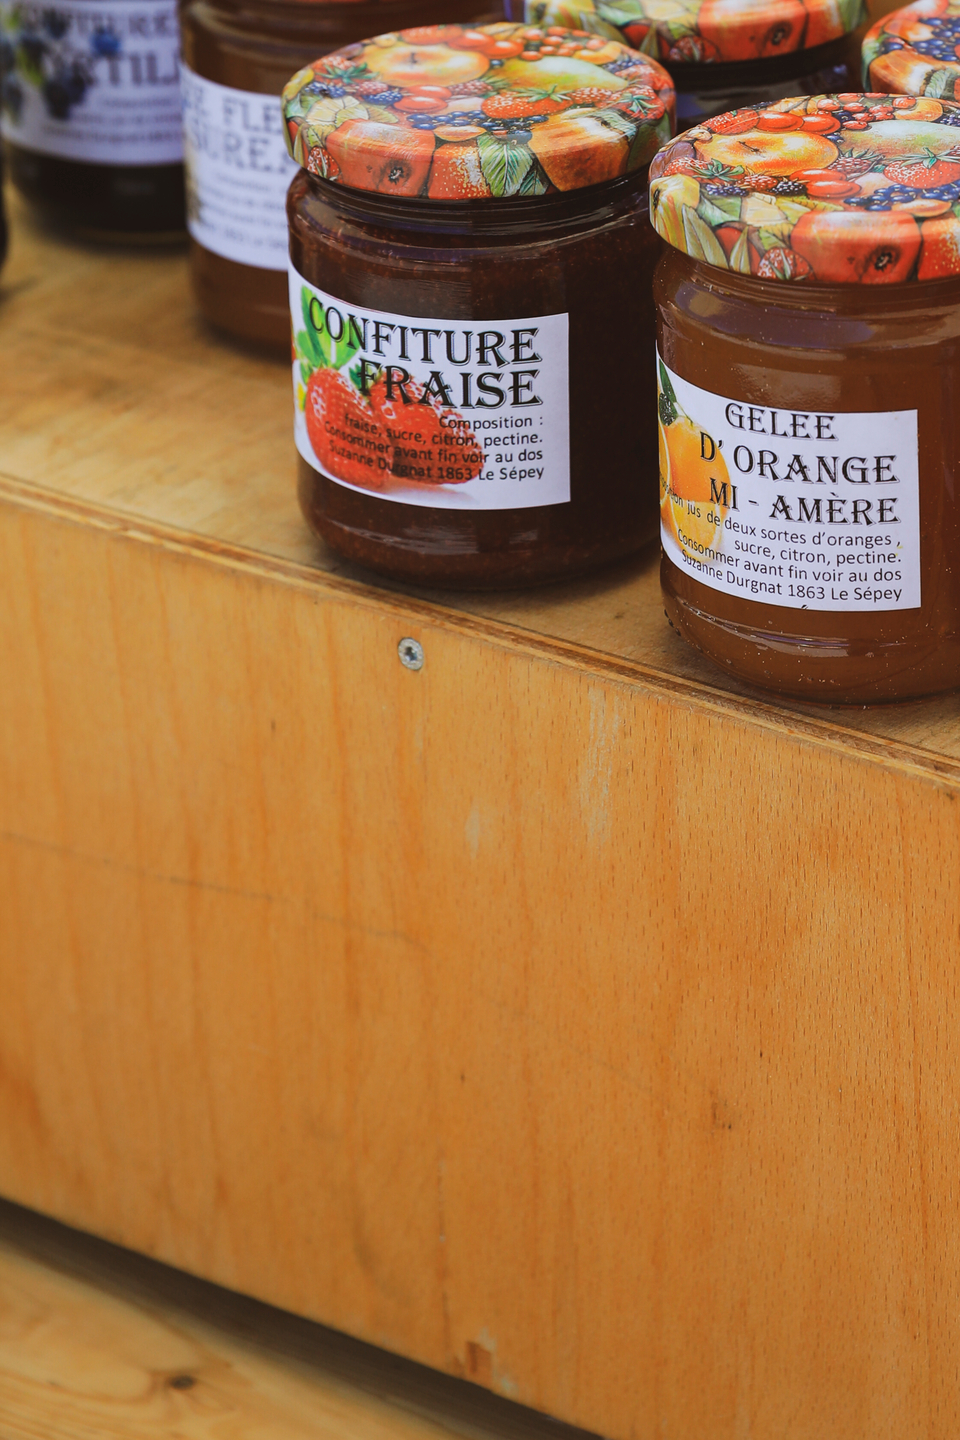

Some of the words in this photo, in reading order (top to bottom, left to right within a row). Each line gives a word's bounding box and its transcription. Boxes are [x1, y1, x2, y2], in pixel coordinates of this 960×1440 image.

[308, 297, 543, 369] CONFITURE
[358, 357, 544, 410] FRAISE
[324, 421, 390, 454] Consommer
[394, 445, 433, 460] avant
[437, 449, 457, 463] fin
[462, 450, 489, 464] voir
[495, 452, 513, 464] au
[518, 448, 543, 462] dos
[344, 413, 382, 437] fraise,
[386, 427, 427, 445] sucre,
[431, 434, 478, 447] citron,
[483, 433, 543, 449] pectine.
[439, 416, 533, 432] Composition
[724, 402, 838, 441] GELEE
[329, 439, 374, 467] Suzanne
[378, 457, 432, 479] Durgnat
[437, 466, 473, 481] 1863
[478, 468, 495, 481] Le
[500, 465, 545, 482] Sépey
[687, 499, 701, 518] jus
[706, 510, 721, 527] de
[724, 517, 757, 537] deux
[760, 528, 807, 545] sortes
[708, 477, 741, 511] MI
[769, 491, 902, 526] AMÈRE
[677, 528, 740, 568] Consommer
[743, 560, 784, 578] avant
[788, 566, 808, 581] fin
[813, 568, 843, 582] voir
[848, 570, 868, 582] au
[873, 566, 902, 582] dos
[734, 539, 776, 560] sucre,
[780, 548, 831, 567] citron,
[836, 549, 902, 567] pectine.
[681, 549, 723, 581] Suzanne
[726, 570, 783, 596] Durgnat
[787, 583, 826, 600] 1863
[831, 587, 849, 600] Le
[853, 585, 903, 603] Sépey
